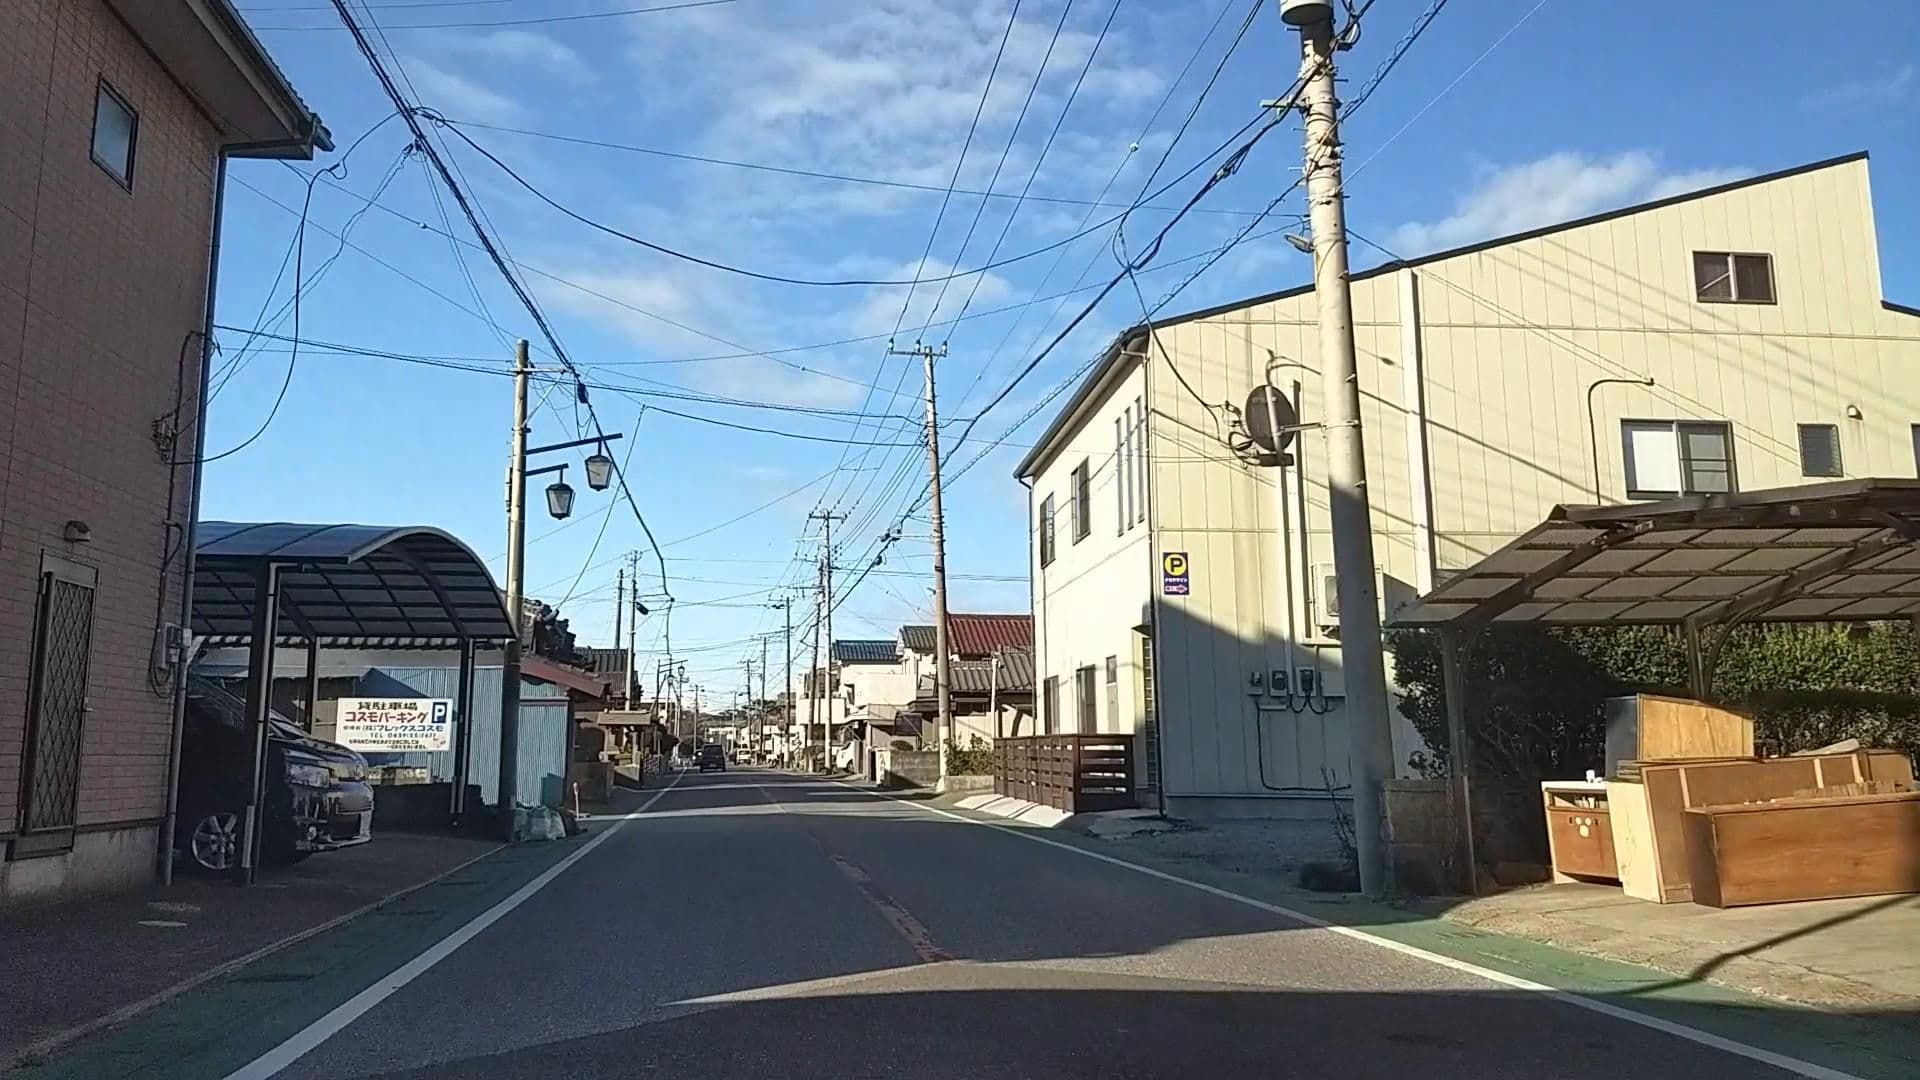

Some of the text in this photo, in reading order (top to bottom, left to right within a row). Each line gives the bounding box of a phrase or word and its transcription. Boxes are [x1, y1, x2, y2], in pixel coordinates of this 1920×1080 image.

[1170, 557, 1183, 573] P
[345, 711, 429, 724] コスモパーキング
[434, 703, 446, 722] P
